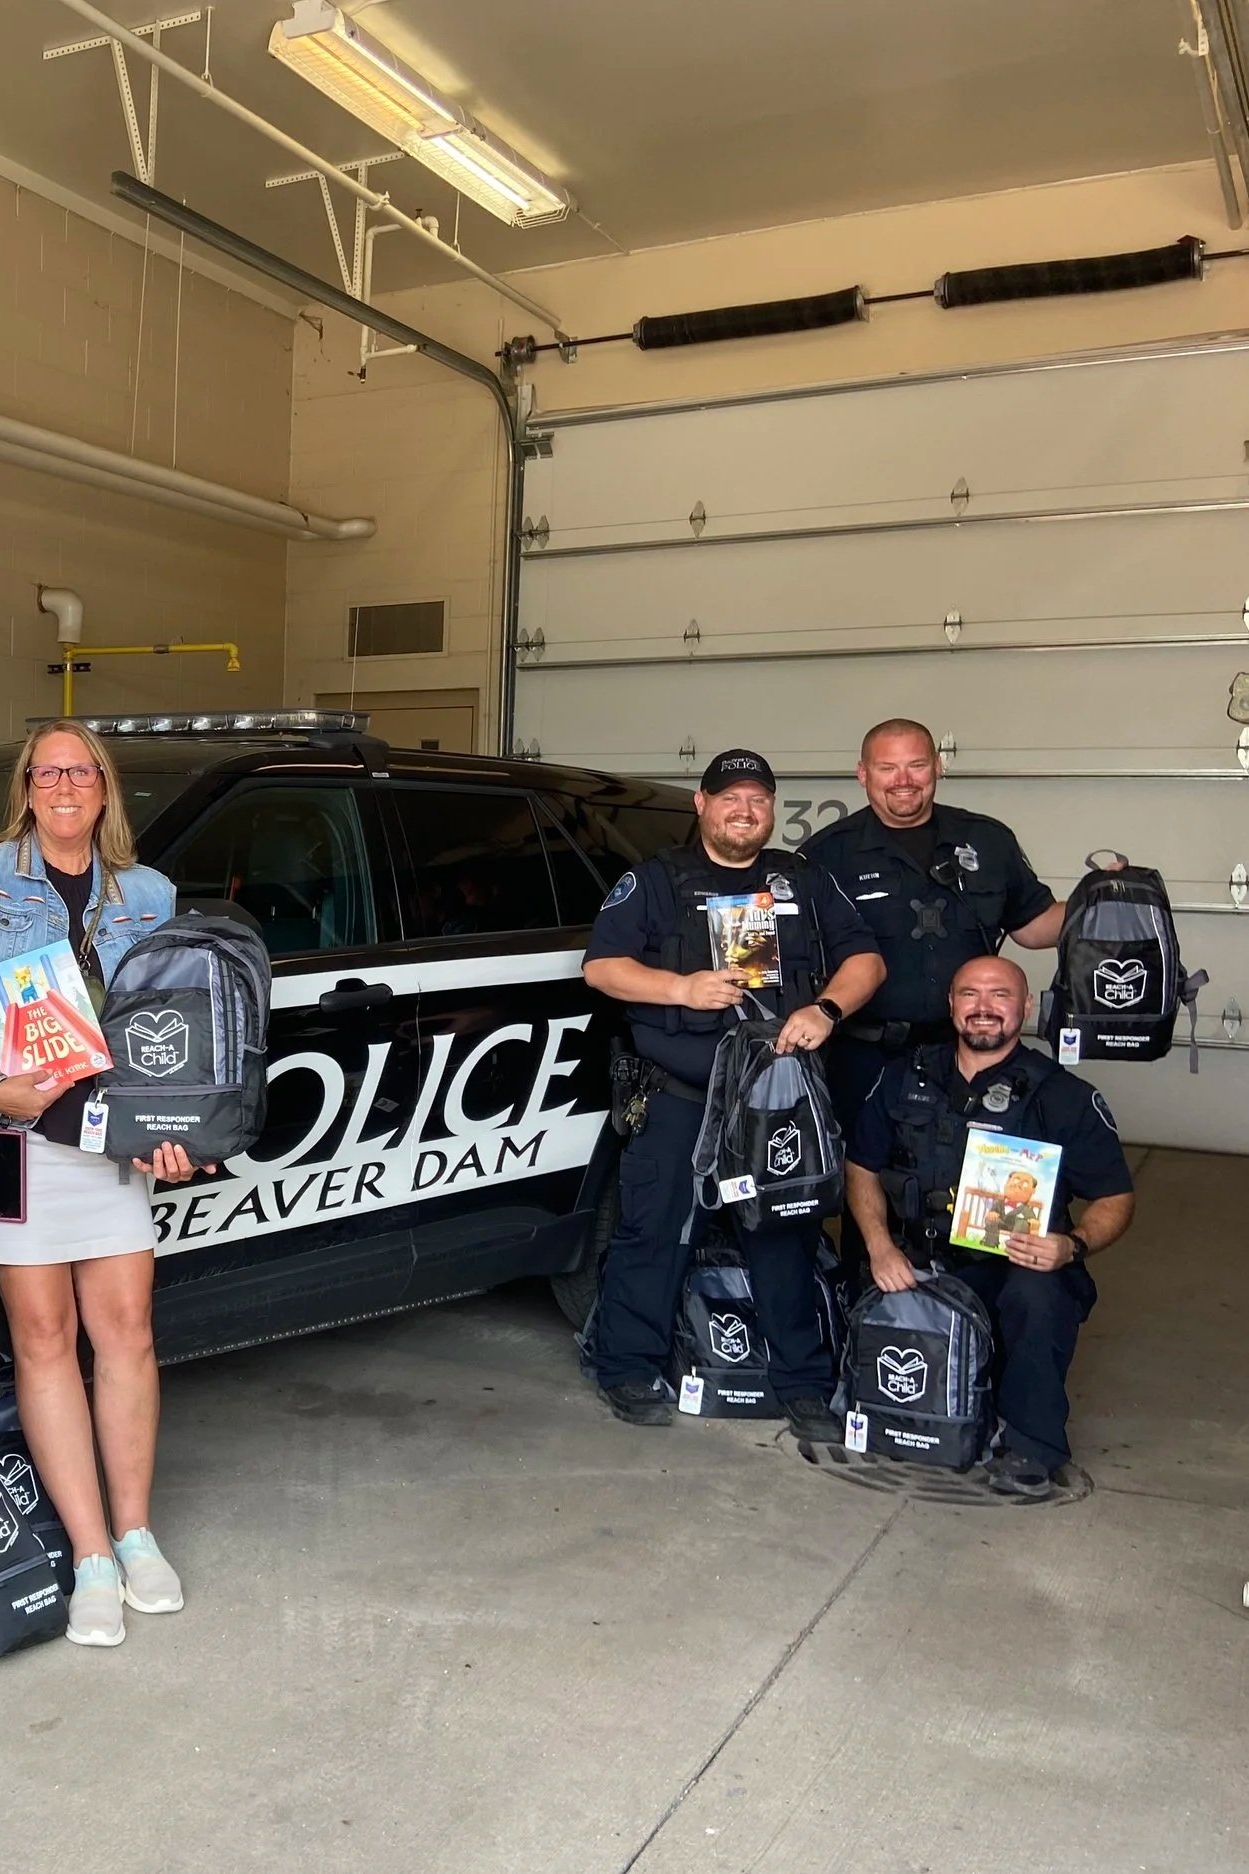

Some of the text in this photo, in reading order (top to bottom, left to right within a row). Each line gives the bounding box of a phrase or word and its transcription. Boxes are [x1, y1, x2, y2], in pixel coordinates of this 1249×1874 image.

[1104, 988, 1134, 1000] Child
[27, 1006, 47, 1020] THE
[24, 1016, 62, 1042] BIG
[1114, 1034, 1150, 1042] RESPONDER
[22, 1032, 86, 1071] SLIDE
[141, 1044, 174, 1052] REACH-A
[141, 1052, 178, 1066] Child
[65, 1061, 88, 1075] KIRK
[225, 1014, 593, 1180] OLICE
[156, 1115, 200, 1123] RESPONDER
[153, 1130, 548, 1245] BEAVER DAM
[772, 1200, 820, 1212] FIRST RESPONDER
[734, 1390, 764, 1398] RESPONDER
[888, 1381, 916, 1394] Child
[885, 1428, 940, 1444] FIRST RESPONDER
[894, 1438, 930, 1450] REACH BAG
[8, 1486, 24, 1496] CH-A
[14, 1492, 30, 1506] ild
[12, 1583, 58, 1610] FIRST RESPONDER
[24, 1595, 56, 1615] REACH BAG
